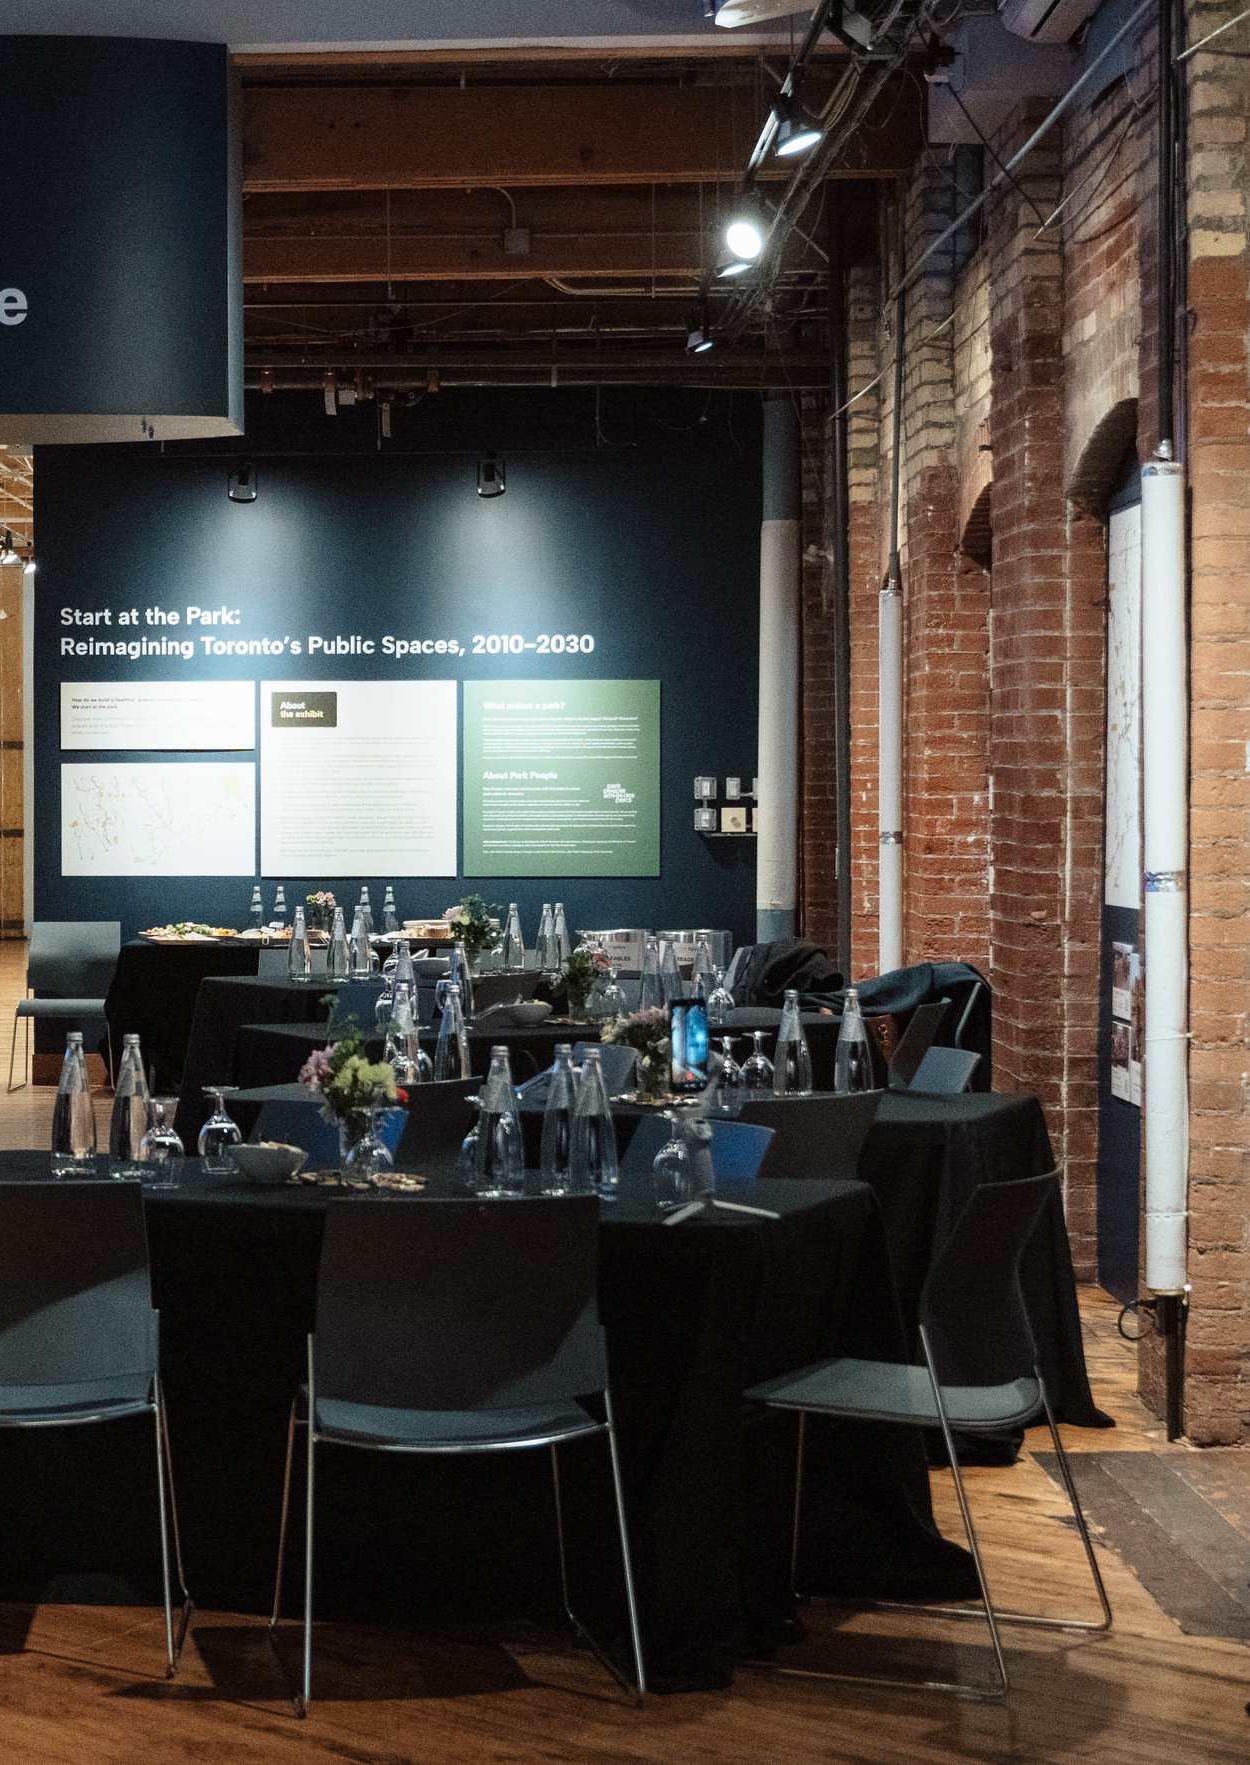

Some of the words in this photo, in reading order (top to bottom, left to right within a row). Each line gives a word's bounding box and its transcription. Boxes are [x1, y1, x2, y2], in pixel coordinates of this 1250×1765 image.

[60, 607, 112, 626] Start
[118, 607, 139, 626] at
[145, 606, 180, 626] the
[186, 606, 241, 626] Park:
[60, 637, 194, 660] Reimagining
[200, 635, 302, 656] Toronto’s
[308, 636, 375, 655] Public
[382, 635, 466, 659] Spaces,
[472, 634, 595, 655] 2010–2030
[280, 701, 306, 710] About
[483, 702, 505, 710] What
[507, 702, 534, 710] makes
[542, 702, 566, 711] park?
[280, 710, 294, 718] the
[295, 710, 324, 718] exhibit
[482, 771, 508, 780] About
[510, 771, 529, 780] Park
[530, 771, 558, 781] People
